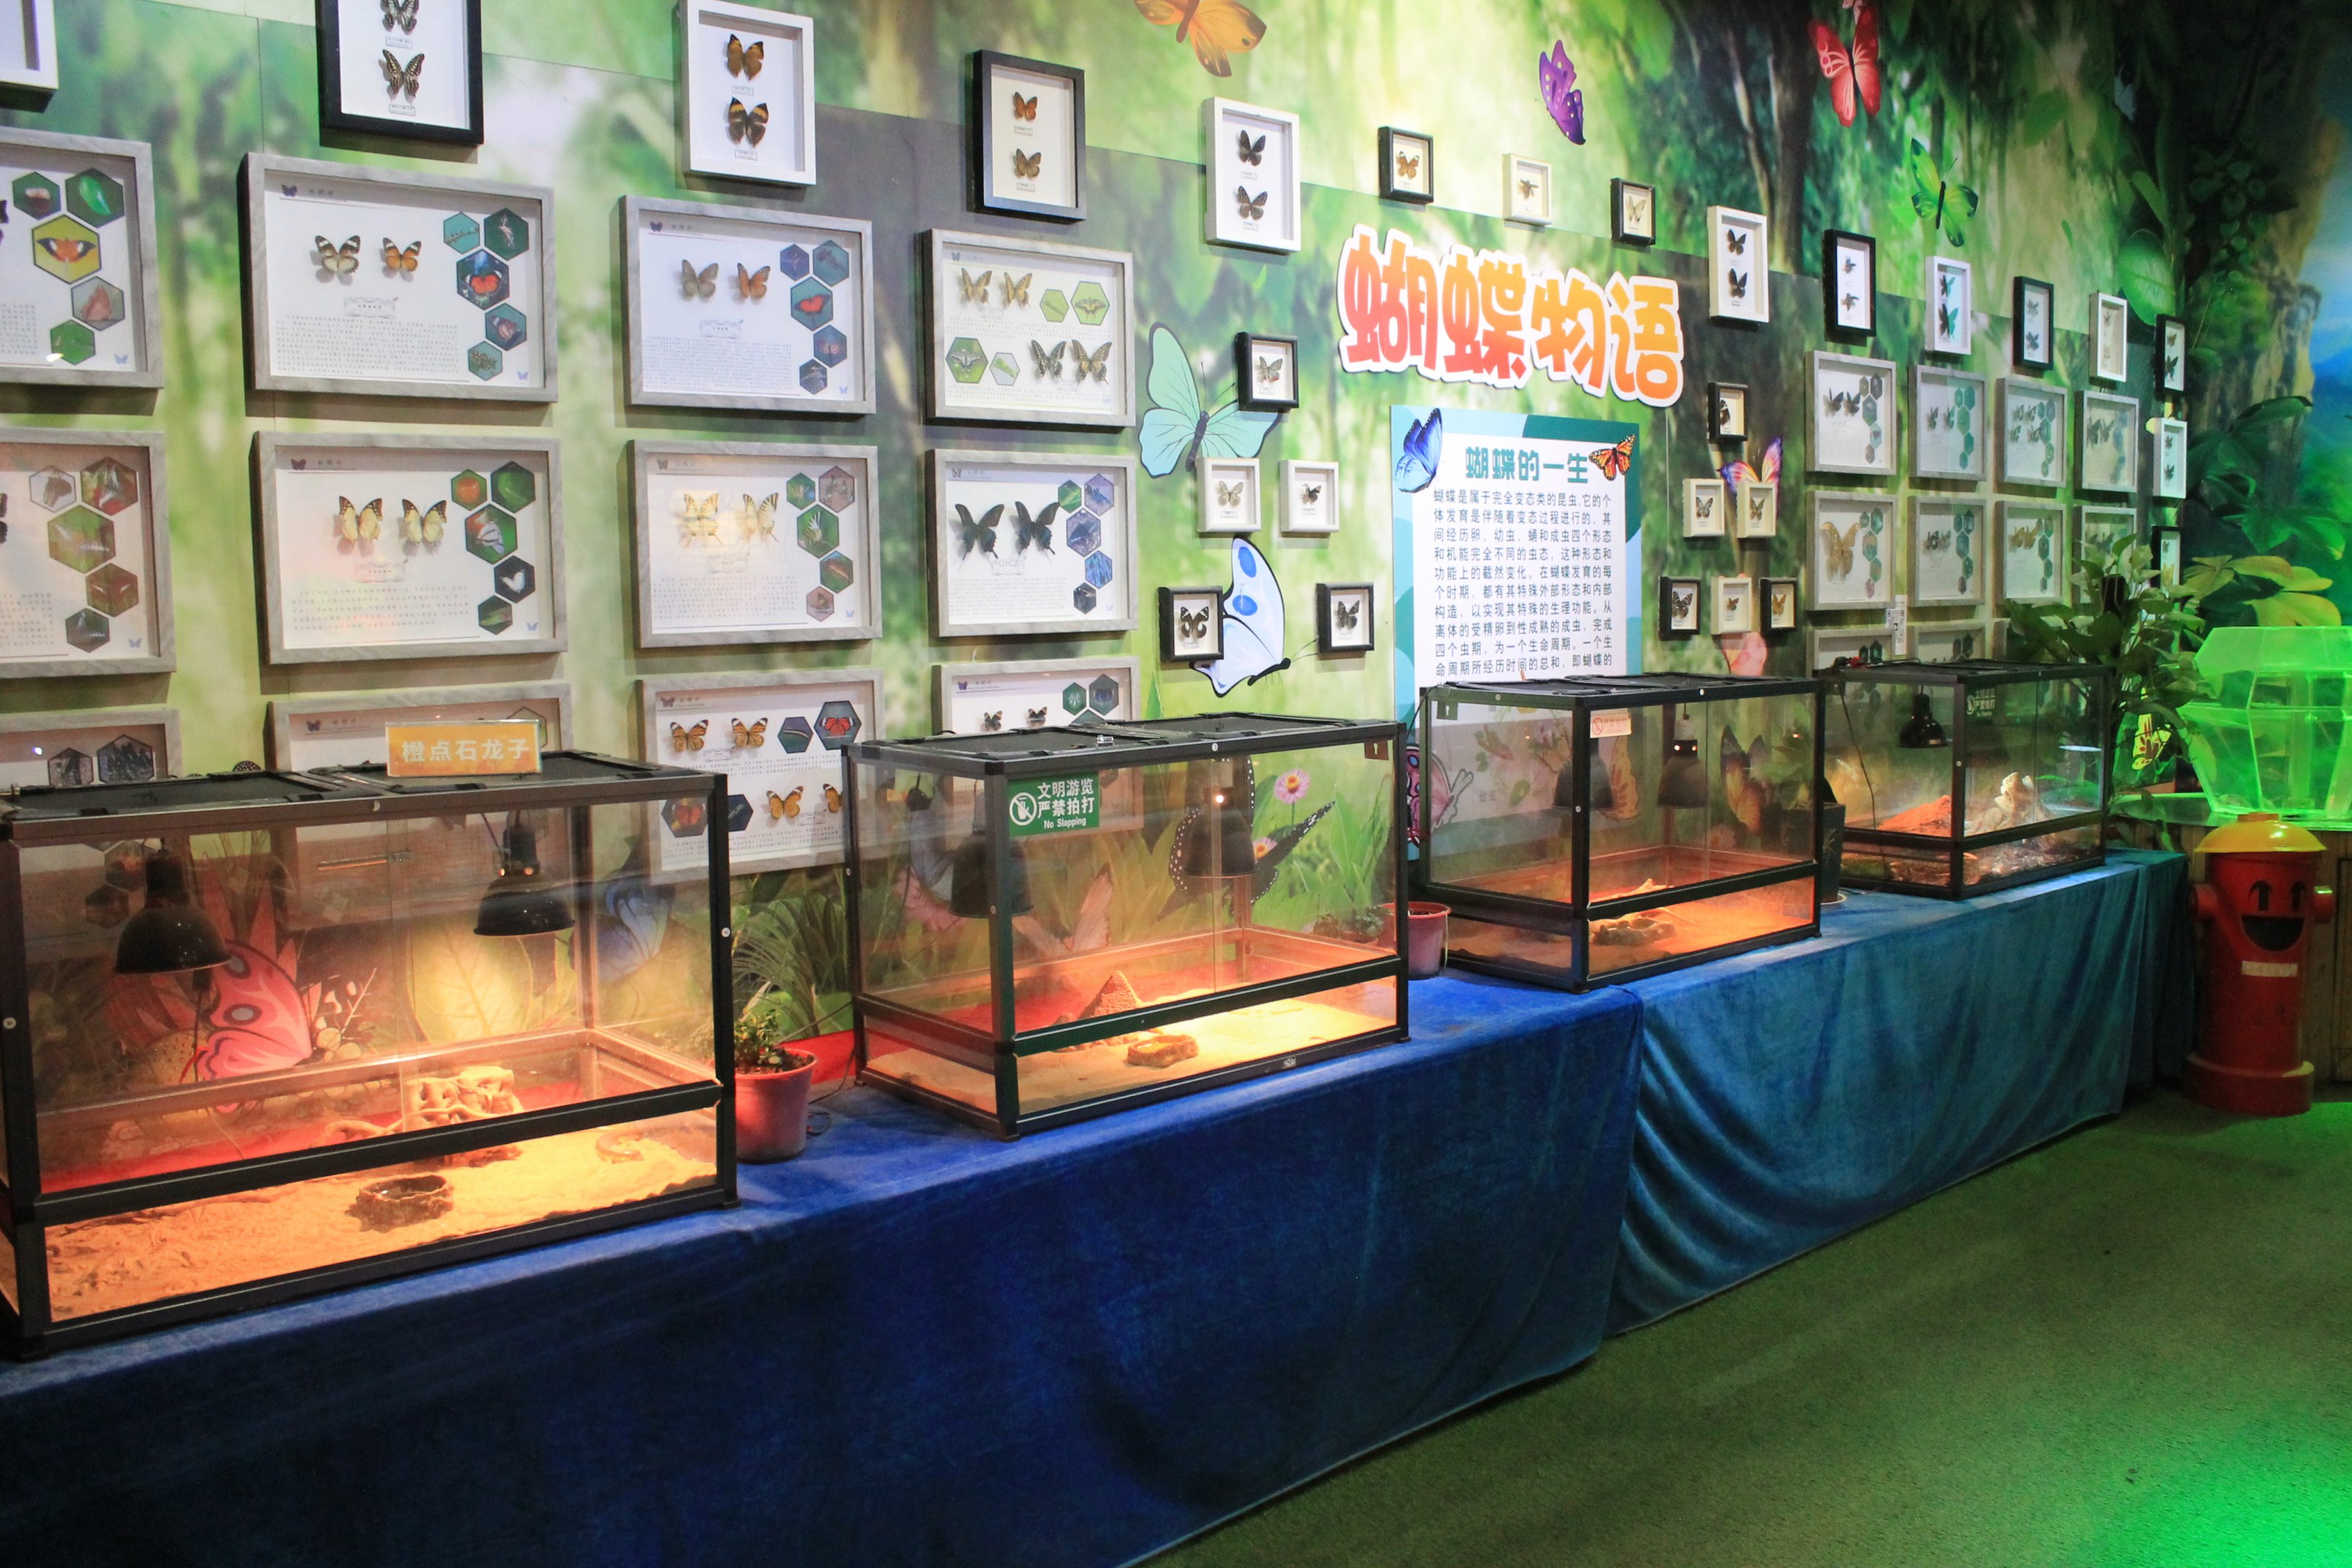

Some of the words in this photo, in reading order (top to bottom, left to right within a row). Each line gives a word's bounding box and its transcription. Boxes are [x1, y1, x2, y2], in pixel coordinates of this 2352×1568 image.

[1344, 234, 1680, 399] 蝴蝶物语
[1466, 446, 1588, 483] 蝴蝶的一生
[401, 738, 529, 762] 橙点石龙子
[1037, 778, 1094, 799] 文明游览
[1037, 796, 1095, 819] 严禁拍打
[1043, 820, 1054, 829] No
[1057, 817, 1087, 828] Slapping
